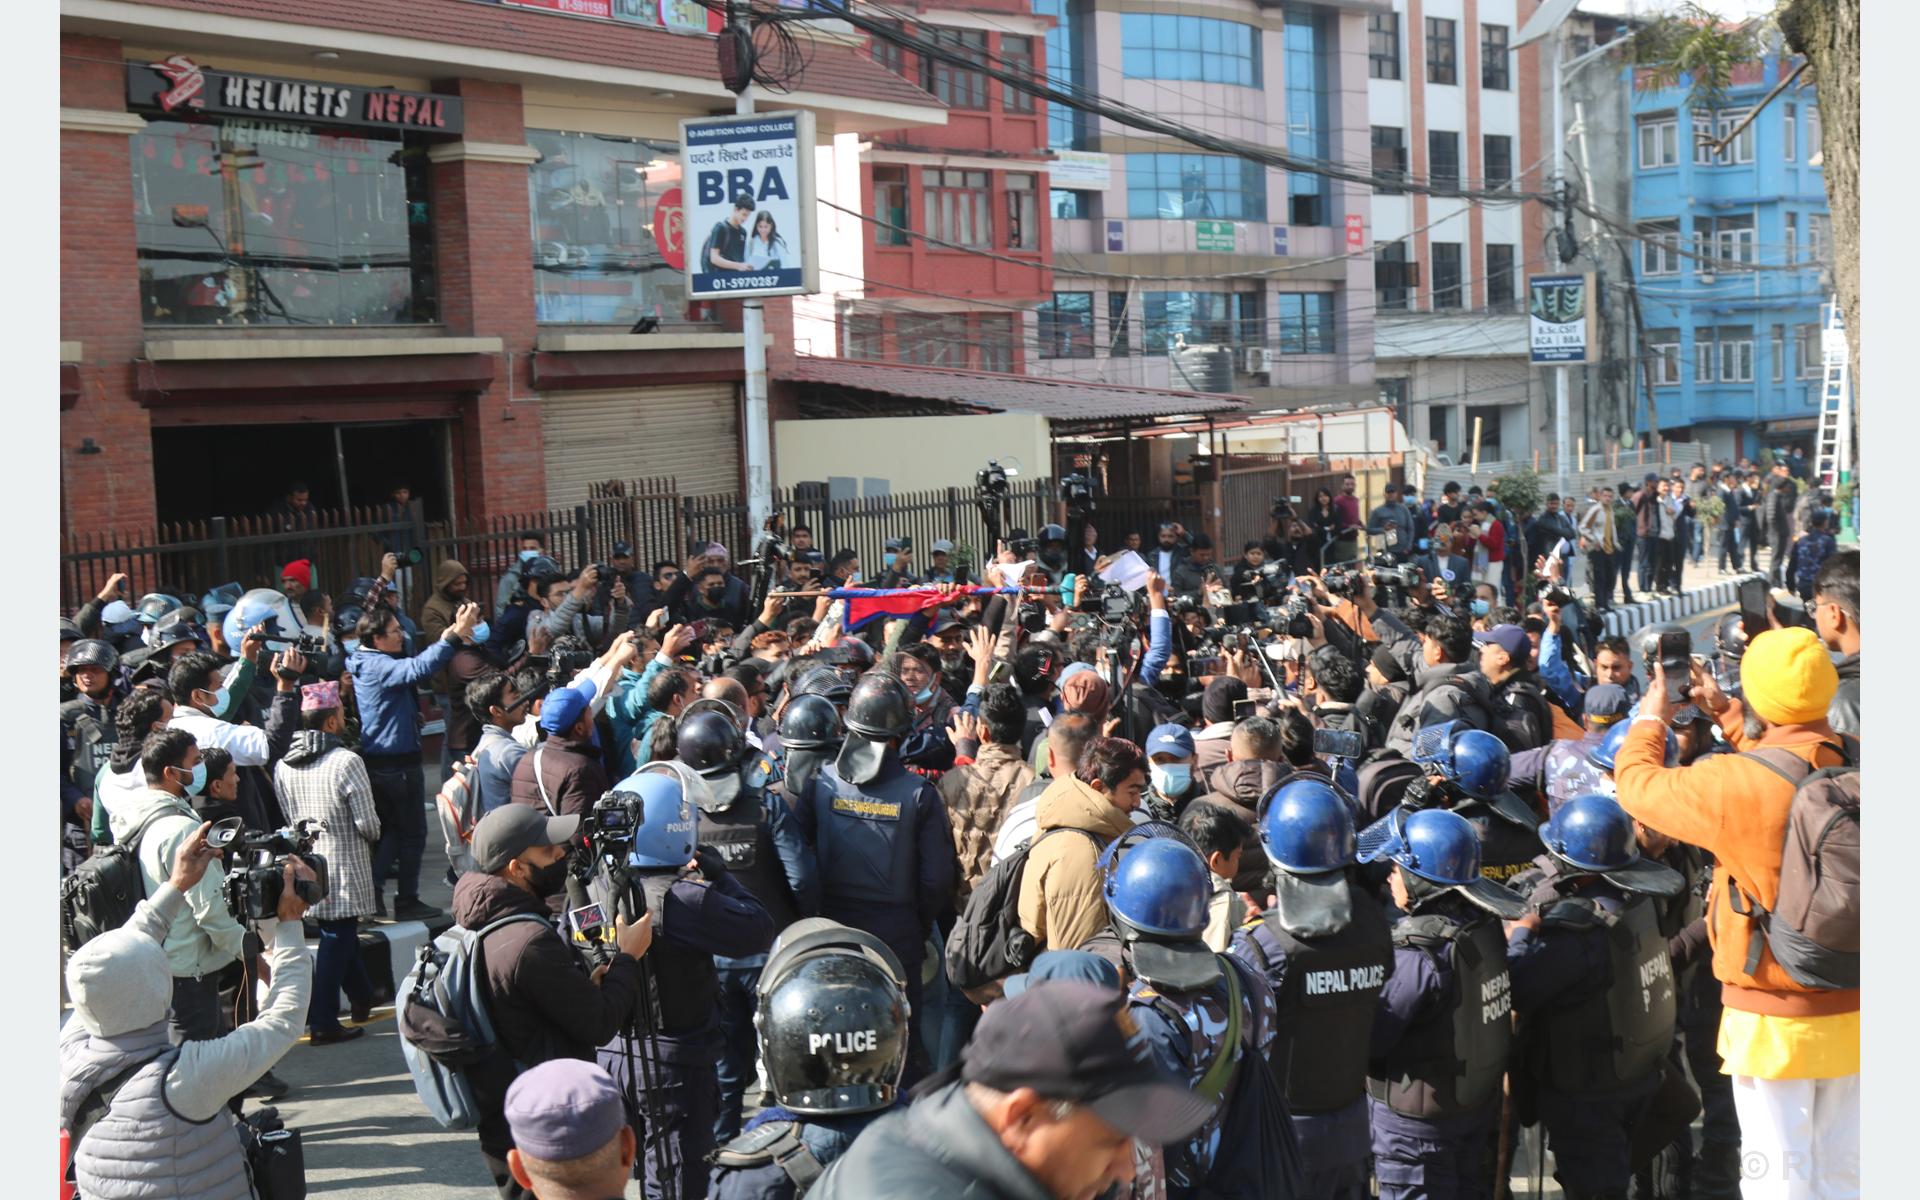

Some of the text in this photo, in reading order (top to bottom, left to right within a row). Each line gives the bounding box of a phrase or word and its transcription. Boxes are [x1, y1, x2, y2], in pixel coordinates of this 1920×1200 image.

[226, 76, 351, 118] HELMETS
[367, 92, 445, 128] NEPAL
[696, 122, 794, 138] AMBITION GURU COLLEGE
[698, 166, 789, 206] BBA
[712, 276, 779, 289] 01-5970287
[1535, 335, 1581, 345] BCA BBA
[1306, 965, 1384, 995] NEPAL POLICE
[1481, 969, 1511, 1003] NEPAL
[1640, 951, 1669, 988] NEPAL
[1482, 991, 1512, 1024] POLICE
